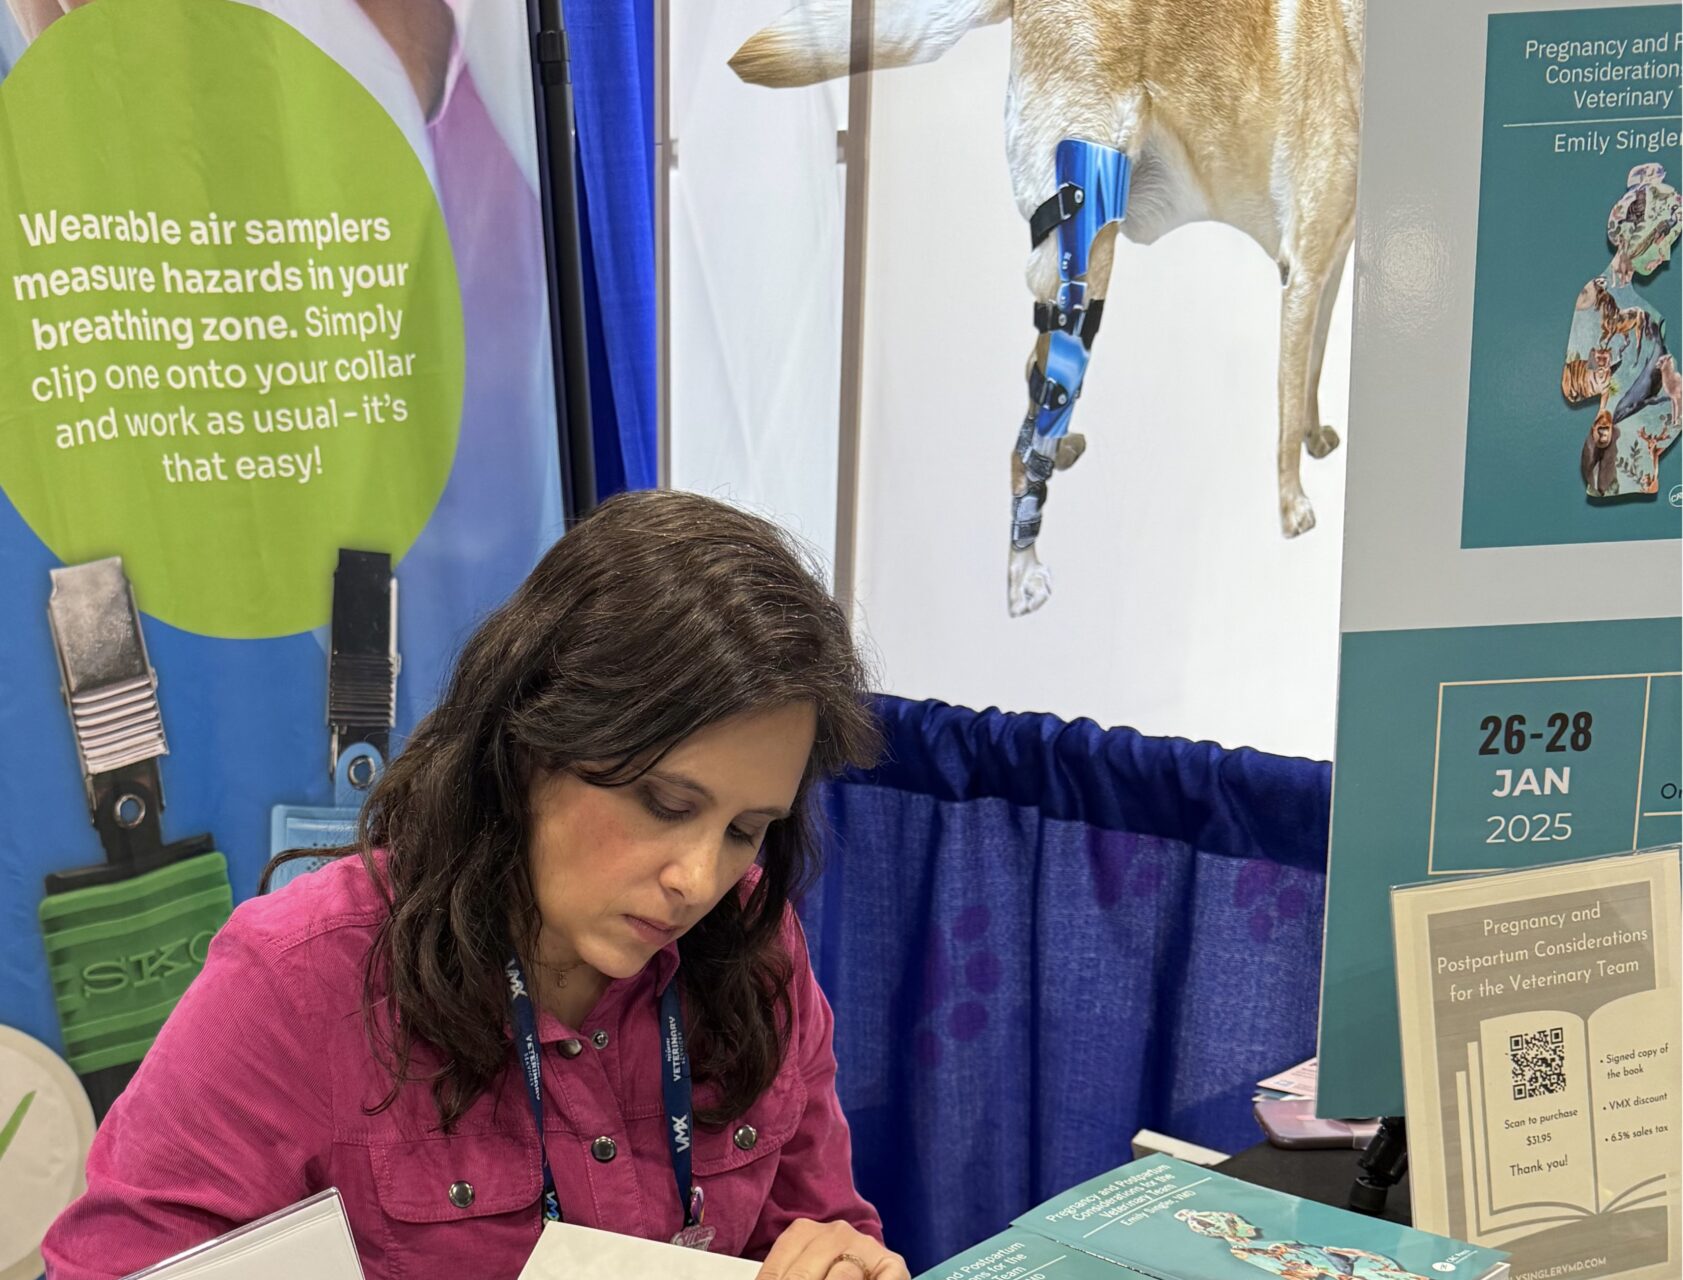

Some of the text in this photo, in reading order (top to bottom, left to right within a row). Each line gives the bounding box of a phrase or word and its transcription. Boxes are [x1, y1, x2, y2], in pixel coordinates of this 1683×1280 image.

[1525, 39, 1628, 62] Pregnancy
[1632, 32, 1668, 54] and
[1574, 88, 1673, 110] Veterinary
[1554, 131, 1610, 155] Emily
[19, 210, 391, 249] Wearable air samplers
[13, 259, 409, 300] measure hazards in your
[32, 304, 402, 350] breathing zone. Simply
[31, 350, 416, 402] clip one onto your collar
[56, 394, 408, 449] and work as usual it's
[162, 445, 323, 484] that easy!
[1478, 712, 1593, 755] 26-28
[1492, 767, 1570, 797] JAN
[1486, 813, 1572, 843] 2025
[1484, 901, 1601, 936] Pregnancy and
[1438, 929, 1648, 974] Postpartum Considerations
[1450, 959, 1639, 1003] for the Veterinary Team
[1606, 1043, 1669, 1065] Signed copy of
[1607, 1065, 1643, 1079] the book
[1609, 1093, 1667, 1110] VMX discount
[672, 1115, 690, 1152] VMX
[1504, 1109, 1578, 1129] Scan to purchase
[1611, 1124, 1668, 1142] 6.5% sales tax
[1527, 1133, 1552, 1146] $31.95
[1510, 1154, 1568, 1176] Thank you!
[960, 1242, 1025, 1273] Postpartum
[989, 1262, 1006, 1273] for
[1004, 1253, 1027, 1264] the
